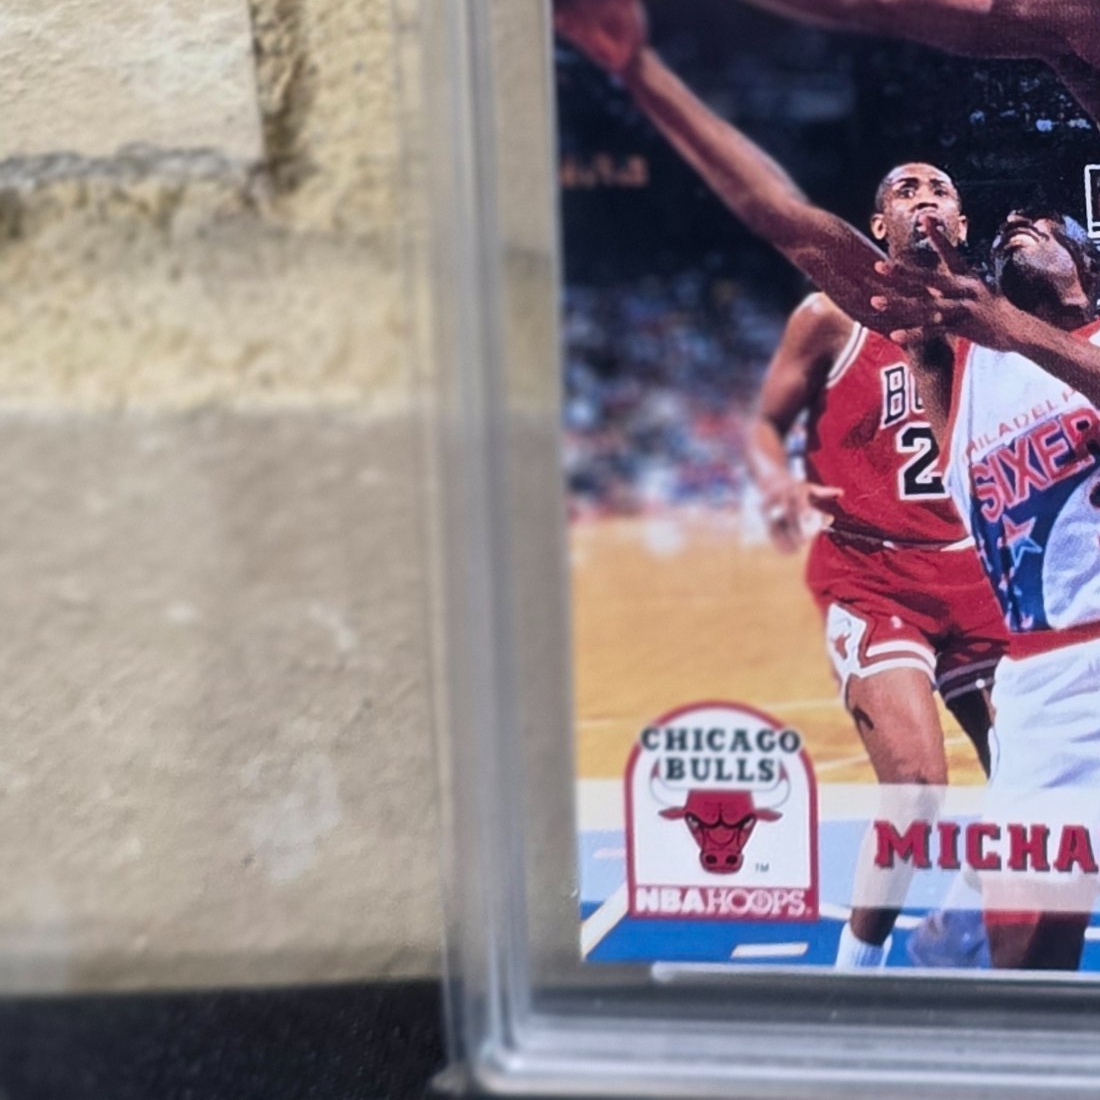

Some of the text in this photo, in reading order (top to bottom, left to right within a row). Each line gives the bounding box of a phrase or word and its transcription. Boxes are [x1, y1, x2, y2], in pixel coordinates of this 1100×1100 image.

[896, 421, 951, 501] 2
[640, 727, 802, 754] CHICAGO
[664, 757, 776, 783] BULLS
